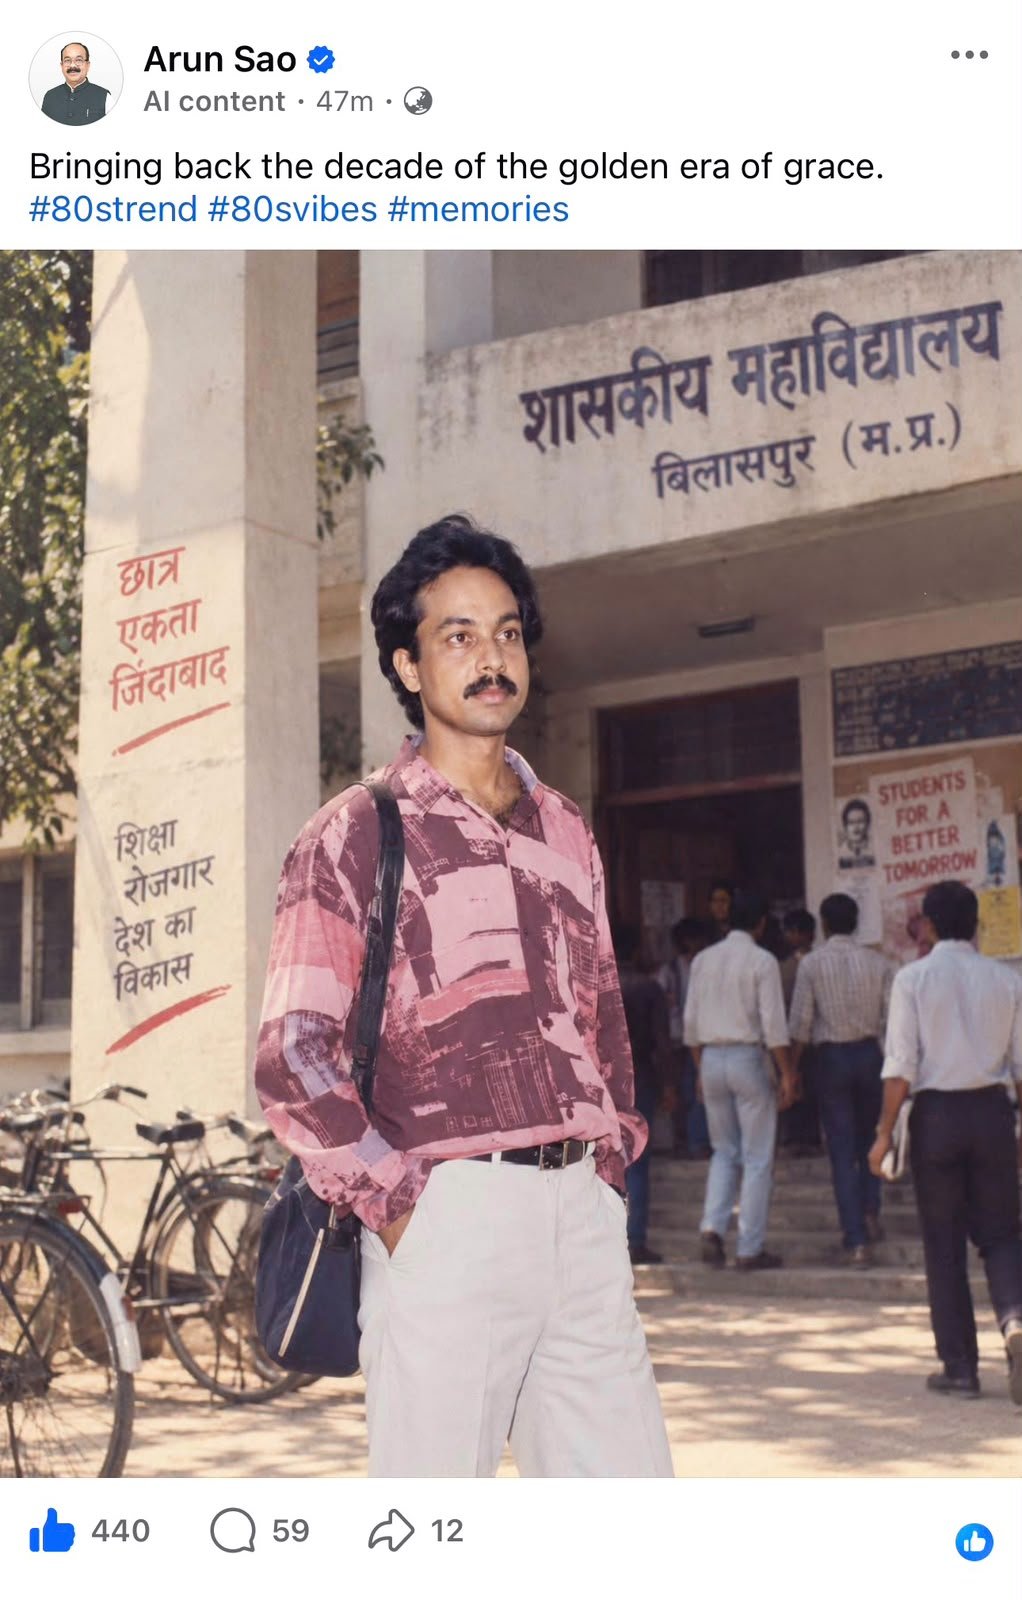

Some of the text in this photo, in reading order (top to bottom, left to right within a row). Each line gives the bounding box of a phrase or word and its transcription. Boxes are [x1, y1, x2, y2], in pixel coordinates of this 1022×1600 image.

[520, 301, 1003, 453] शासकीय महाविद्यालय
[652, 434, 816, 499] बिलासपुर
[117, 546, 186, 596] छात्र
[116, 598, 202, 655] एकता
[108, 645, 231, 712] जिंदाबाद
[878, 770, 966, 807] STUDENTS
[895, 801, 950, 828] FOR A
[114, 819, 178, 862] शिक्षा
[891, 825, 960, 856] BETTER
[124, 855, 215, 906] रोजगार
[882, 849, 977, 884] TOMORROW
[113, 906, 197, 957] देश का
[113, 953, 194, 1001] विकास
